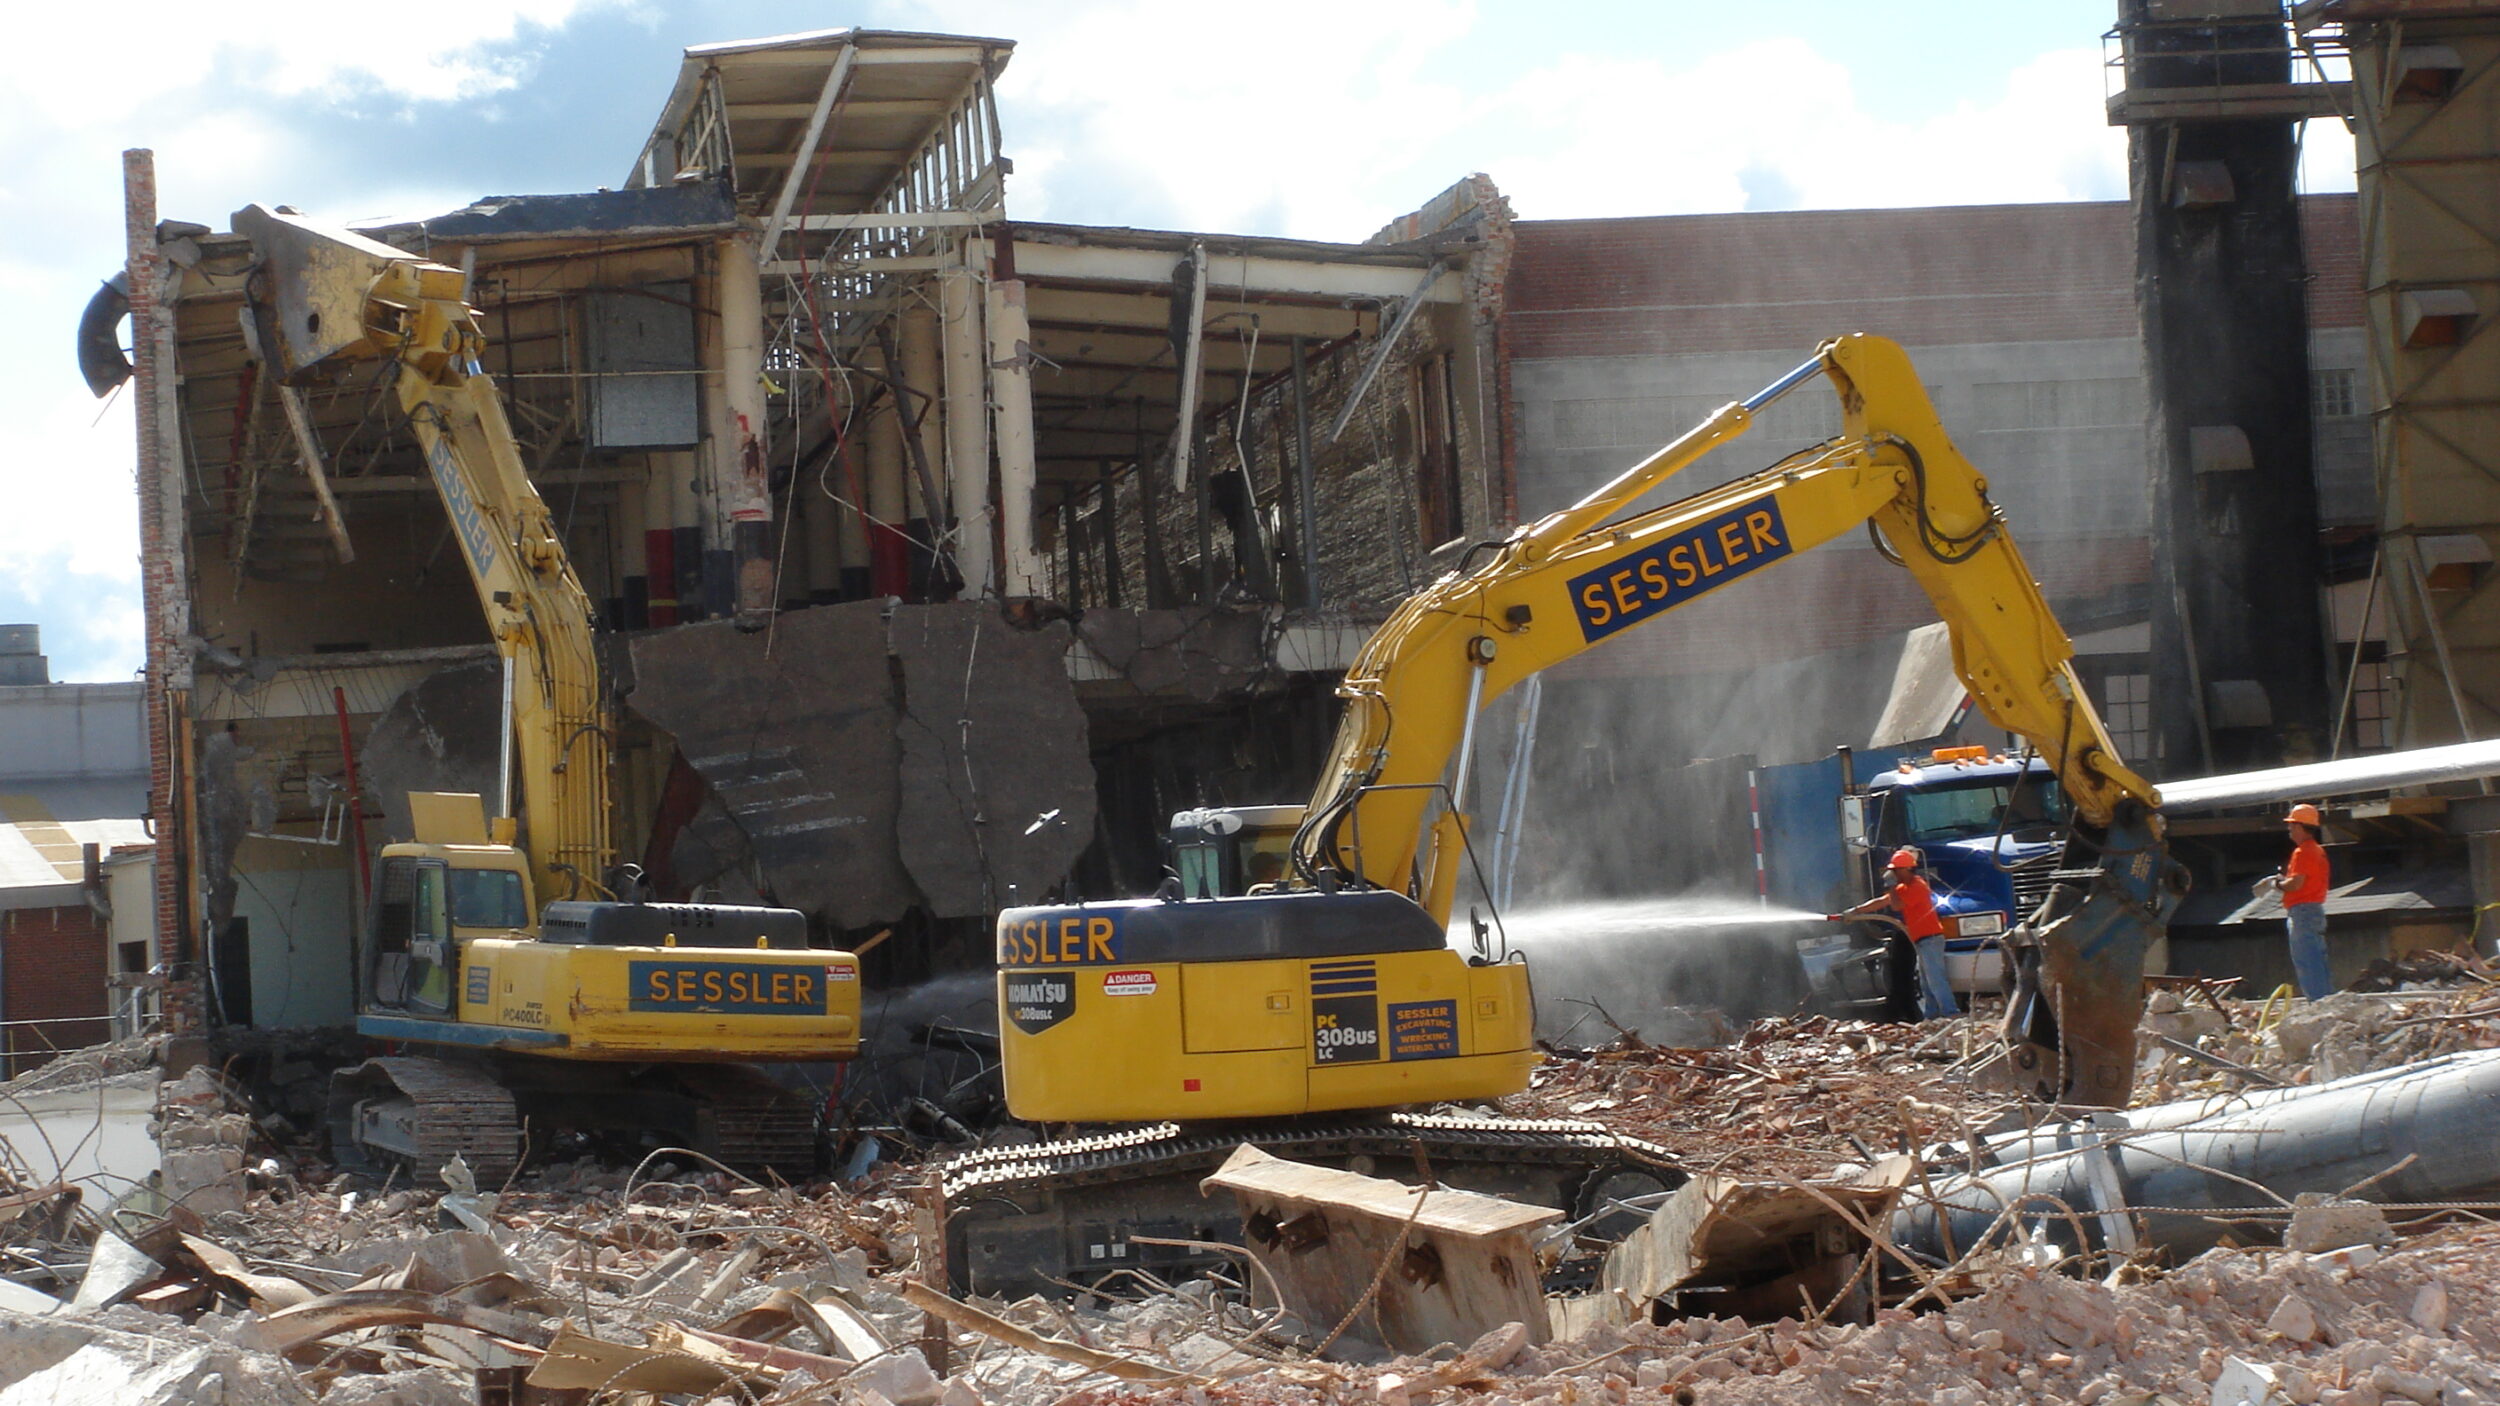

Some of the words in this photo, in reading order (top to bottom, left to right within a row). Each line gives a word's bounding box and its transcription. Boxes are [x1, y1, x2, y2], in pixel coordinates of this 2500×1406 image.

[436, 444, 493, 567] SESSLER
[1582, 510, 1780, 625] SESSLER
[1115, 974, 1152, 984] DANGER
[649, 970, 814, 1006] SESSLER
[1008, 979, 1067, 1003] KOMATSU
[1396, 1007, 1448, 1019] SESSLER
[1317, 1014, 1337, 1028] PC
[1395, 1019, 1451, 1032] EXCAVATING
[1401, 1032, 1448, 1043] WRECKING
[1318, 1047, 1334, 1060] LC
